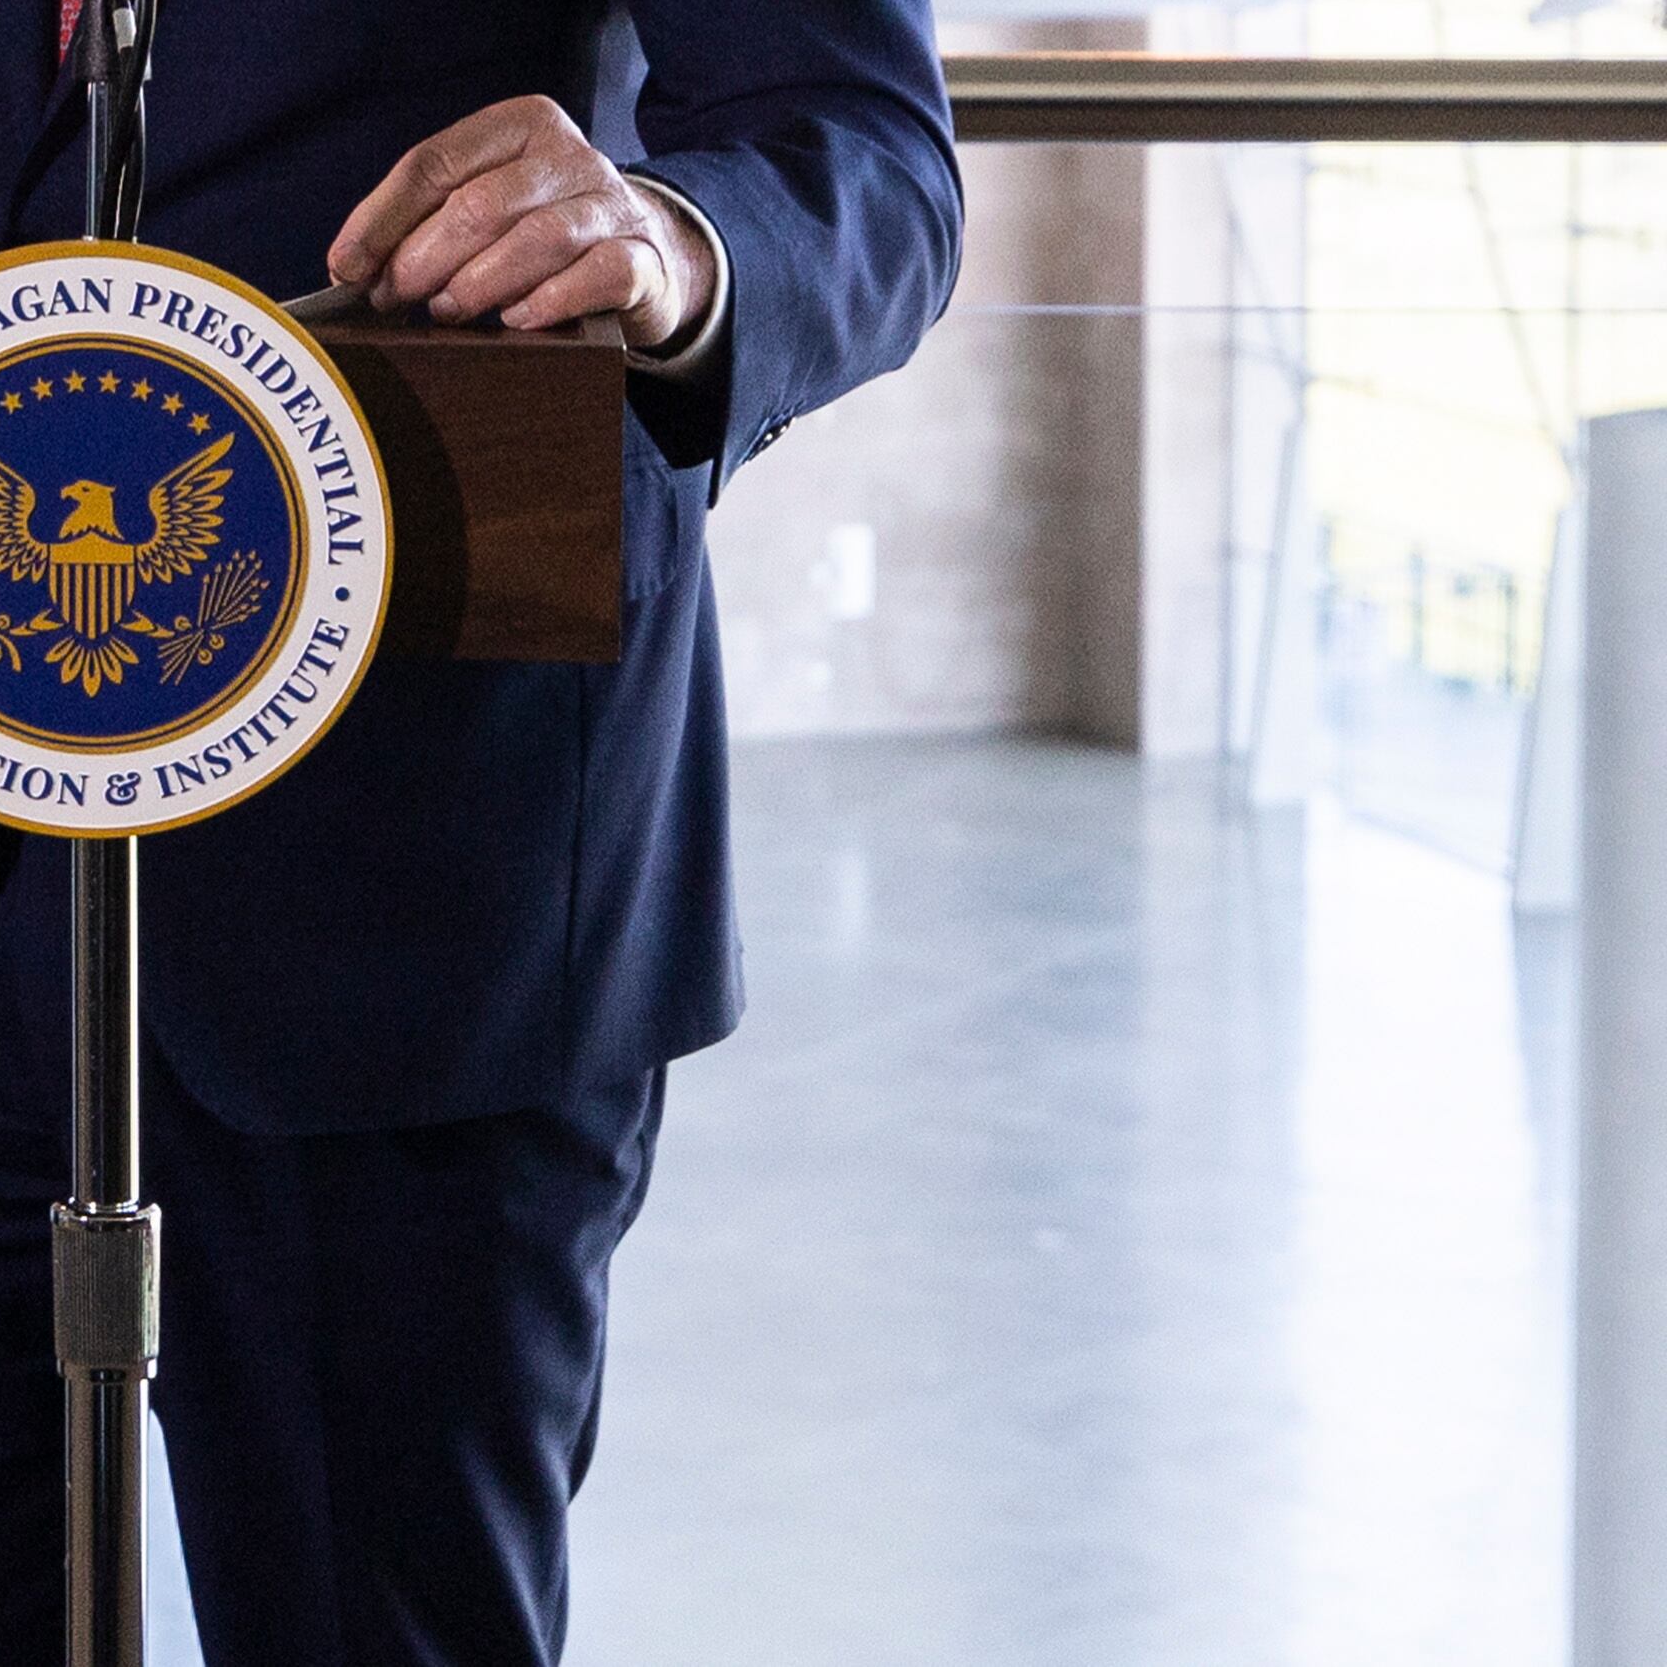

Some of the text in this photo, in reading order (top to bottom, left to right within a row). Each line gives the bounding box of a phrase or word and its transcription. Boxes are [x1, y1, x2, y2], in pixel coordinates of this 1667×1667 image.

[128, 282, 365, 566] PRESIDENTIAL
[104, 770, 142, 805] &
[152, 617, 351, 800] INSTITUTE
